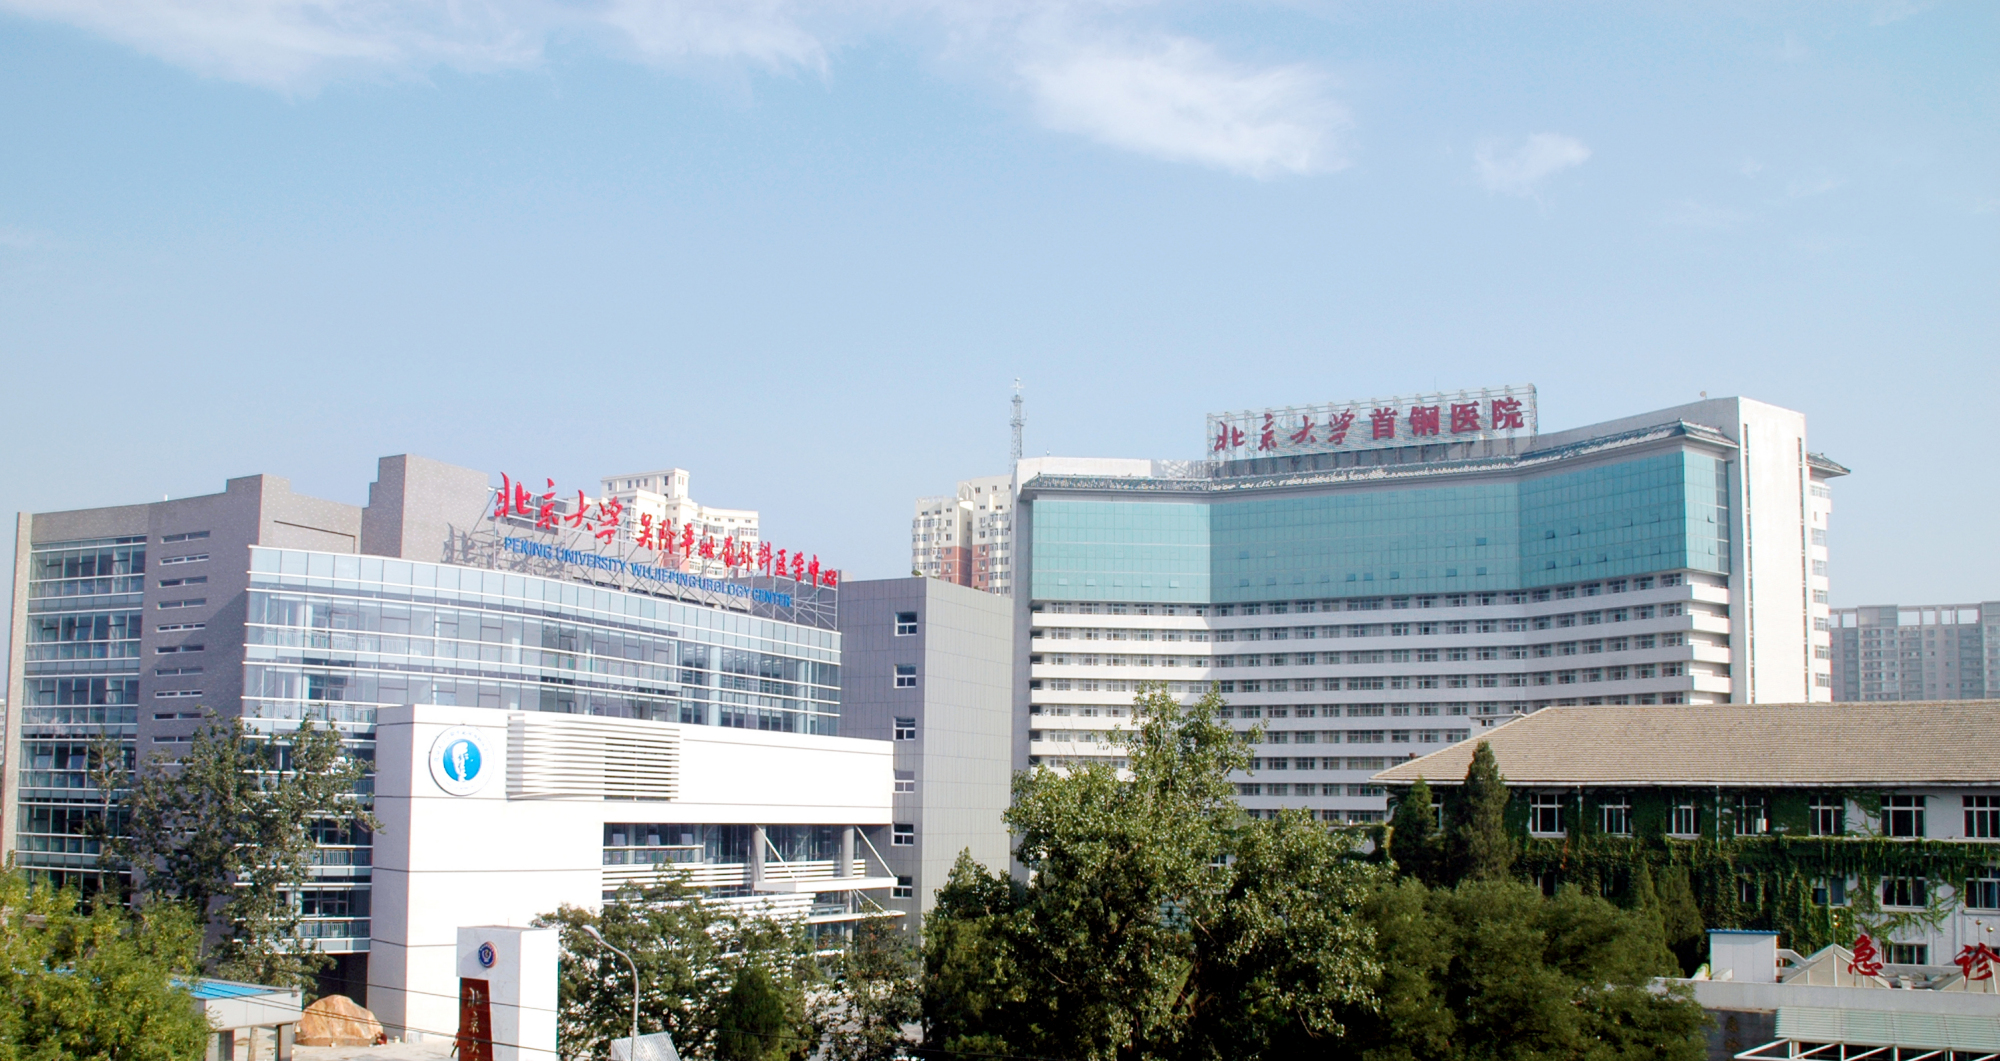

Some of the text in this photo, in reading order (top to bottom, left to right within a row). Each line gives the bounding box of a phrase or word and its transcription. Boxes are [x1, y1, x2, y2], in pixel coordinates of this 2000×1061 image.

[1214, 397, 1525, 452] 北京大学首钢医院
[504, 536, 791, 608] PEKING UNIVERSITY WUJIEPING UROLOGY CENTER
